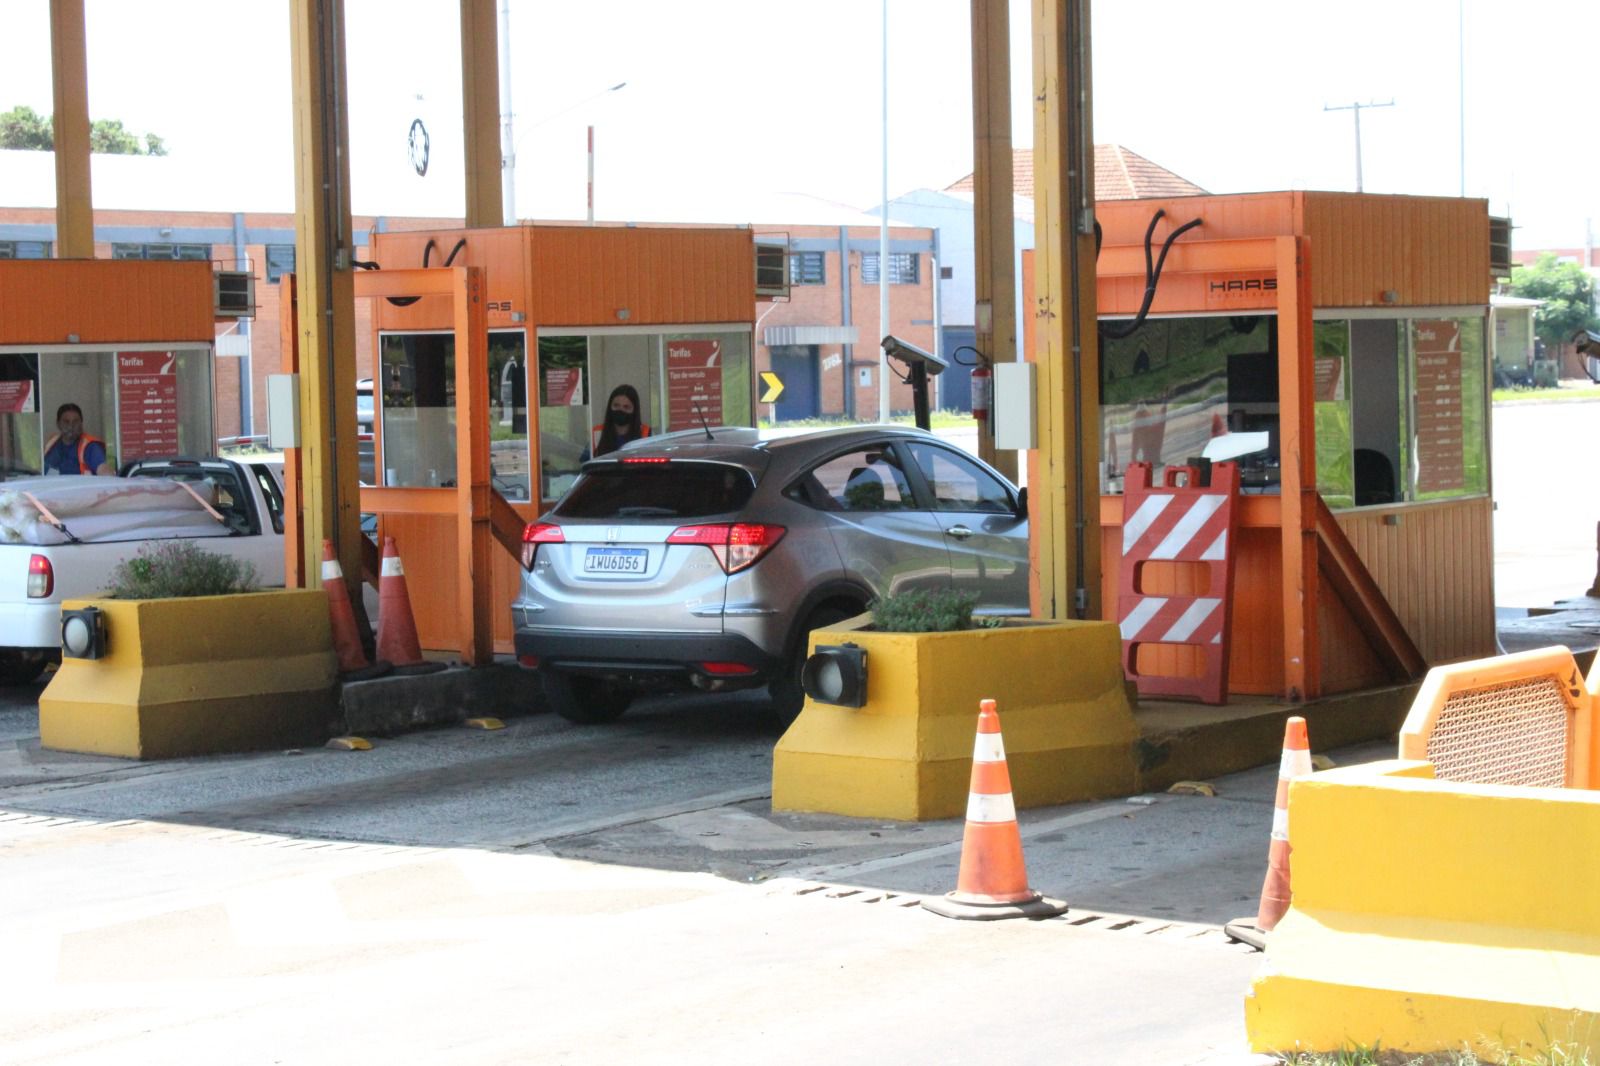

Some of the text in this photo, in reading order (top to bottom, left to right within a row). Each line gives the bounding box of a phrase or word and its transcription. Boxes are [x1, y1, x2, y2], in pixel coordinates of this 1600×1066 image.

[1210, 279, 1278, 292] HAAS
[669, 348, 691, 358] Tarifas
[120, 357, 144, 366] Tarifas
[589, 556, 639, 570] IWU6D56
